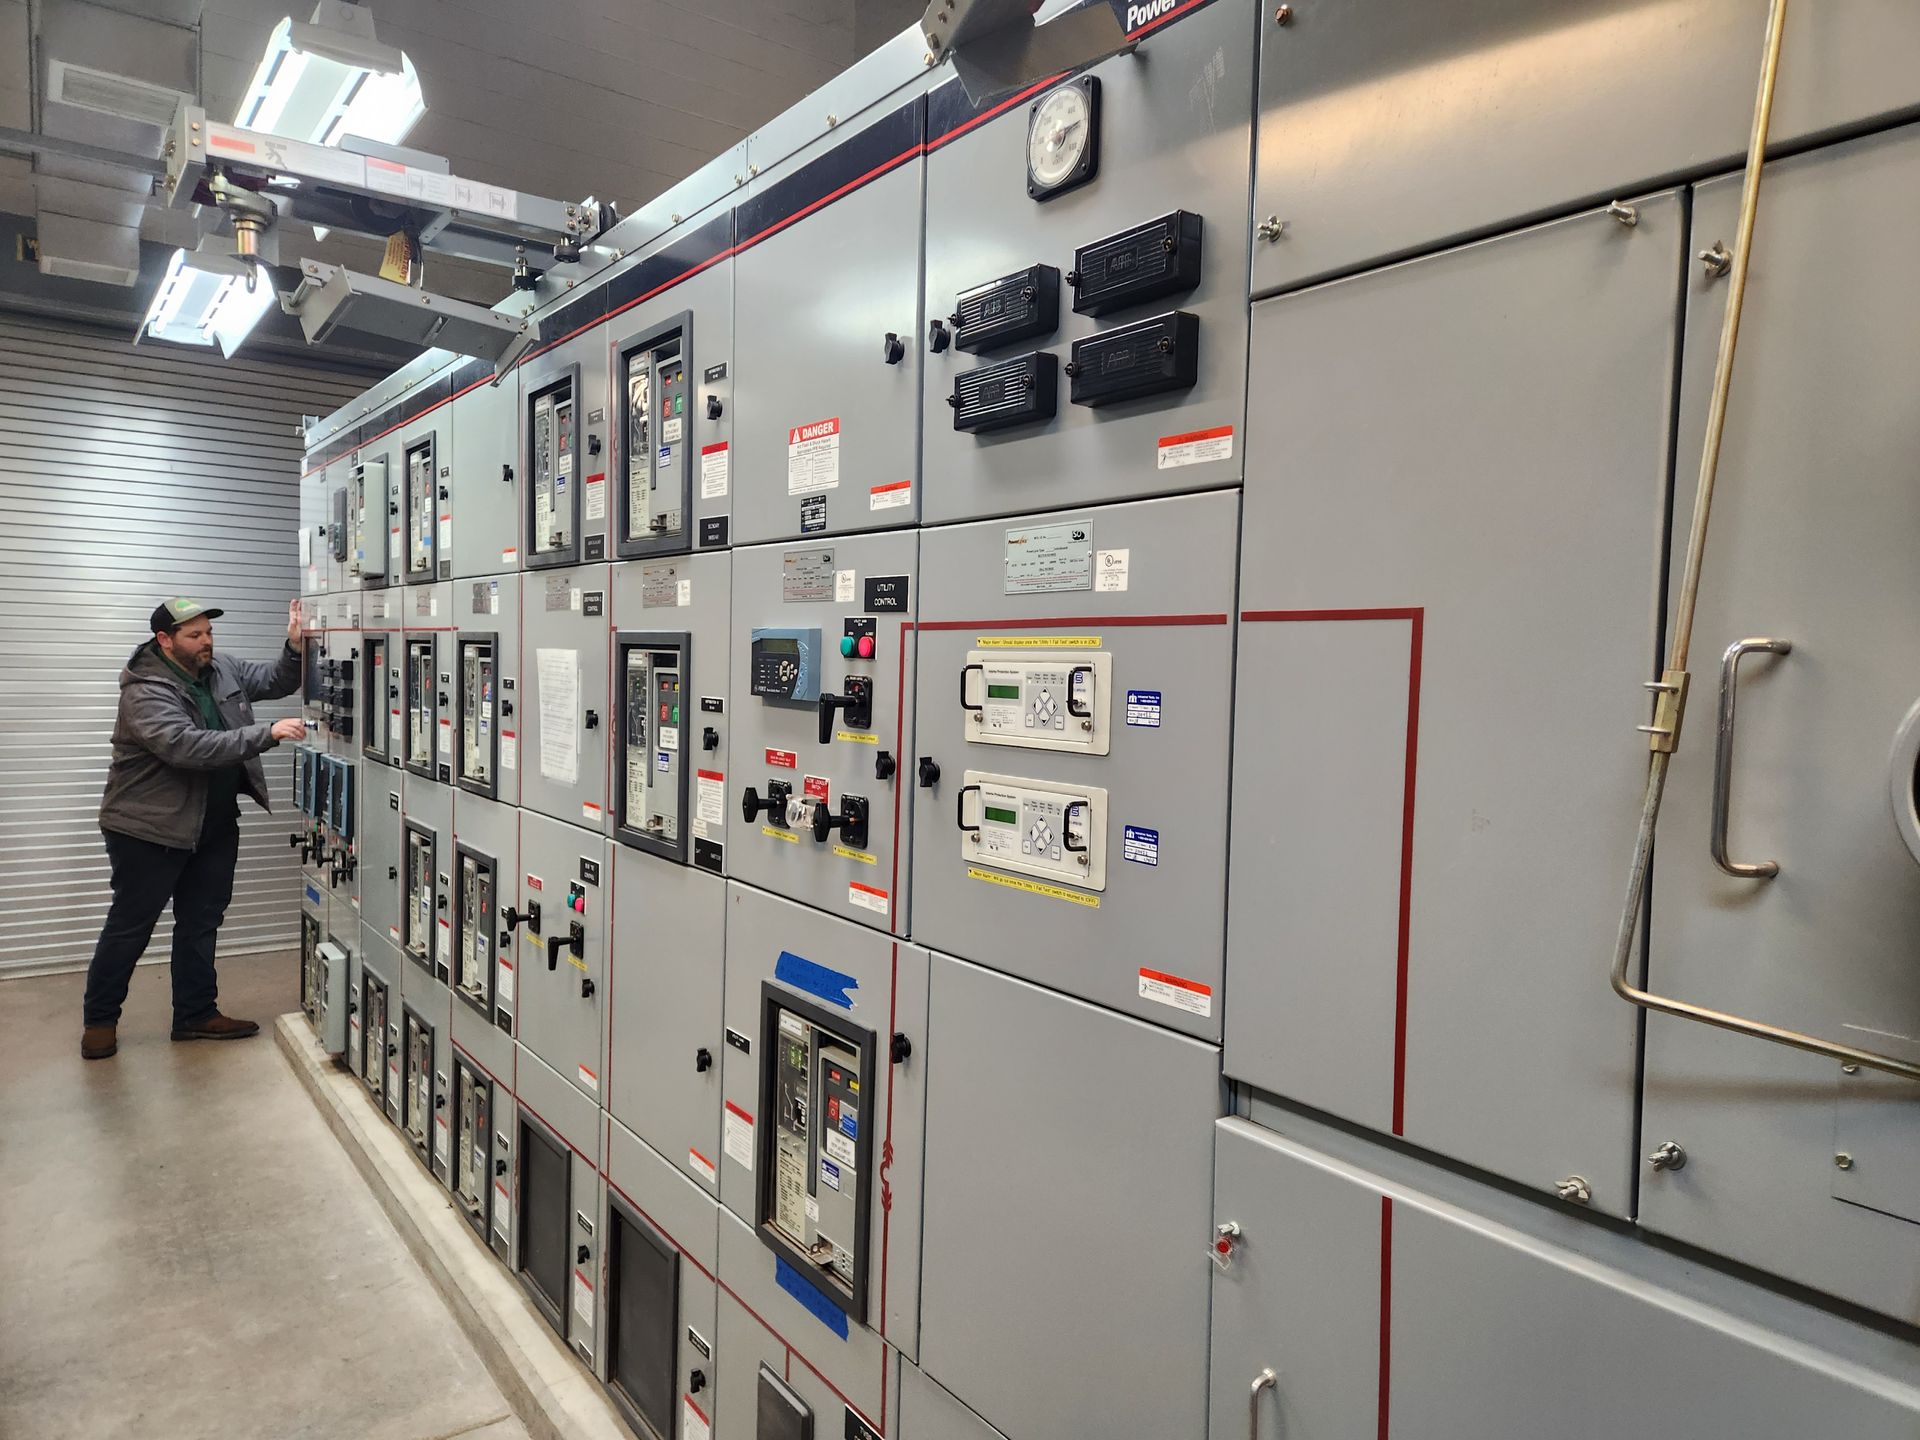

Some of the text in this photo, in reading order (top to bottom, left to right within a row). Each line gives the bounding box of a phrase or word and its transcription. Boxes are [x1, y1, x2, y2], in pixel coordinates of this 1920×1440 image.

[802, 422, 834, 440] DANGER
[877, 583, 896, 592] UTILITY
[874, 597, 898, 606] CONTROL
